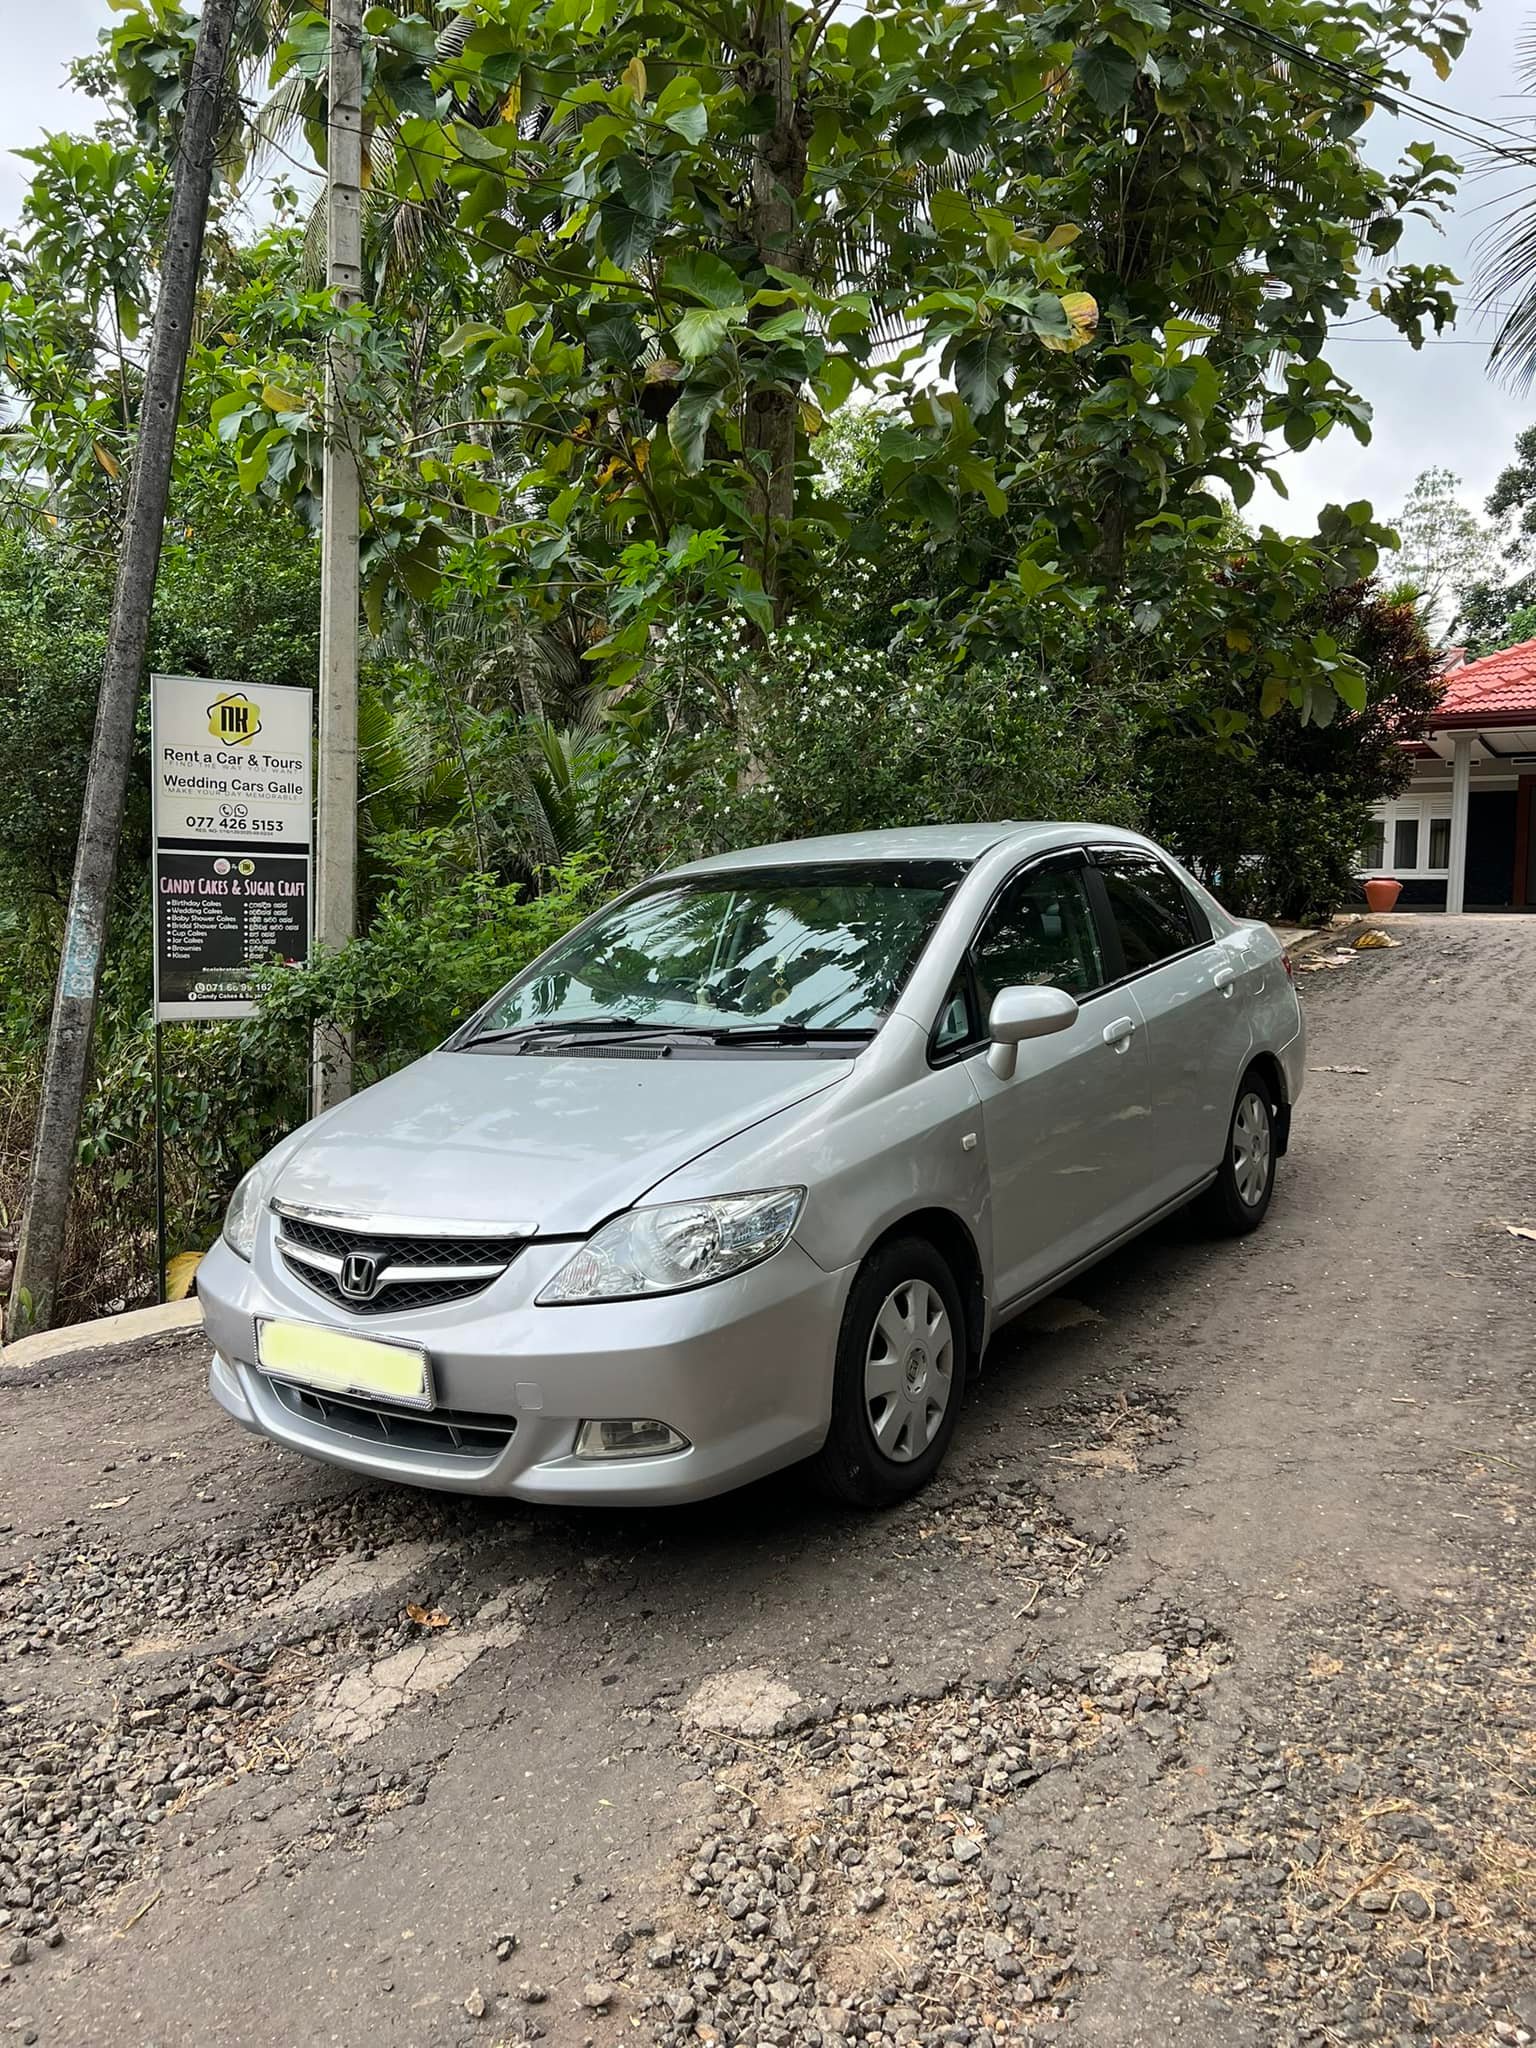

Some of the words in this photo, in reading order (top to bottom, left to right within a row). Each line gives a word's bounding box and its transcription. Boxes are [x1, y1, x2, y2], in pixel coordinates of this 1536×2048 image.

[164, 748, 200, 762] Rent
[203, 753, 212, 763] a
[216, 752, 244, 765] Car
[247, 754, 259, 766] &
[262, 755, 303, 770] Tours
[164, 774, 227, 792] Wedding
[231, 779, 264, 792] Cars
[267, 781, 303, 795] Galle
[197, 788, 220, 796] YOUR
[186, 816, 214, 828] 077
[219, 818, 247, 830] 426
[251, 819, 284, 832] 5153
[159, 876, 195, 894] CANDY
[198, 877, 229, 896] CAKES
[231, 879, 241, 896] &
[244, 879, 276, 896] SUGAR
[277, 880, 305, 897] CRAFT
[171, 899, 200, 908] Birthday
[201, 899, 222, 907] Cakes
[171, 907, 202, 915] Wedding
[202, 907, 223, 915] Cakes
[171, 914, 190, 922] Baby
[191, 914, 216, 922] Shower
[193, 922, 218, 930] Shower
[218, 922, 239, 930] Cakes
[171, 929, 186, 937] Cup
[187, 929, 208, 937] Cakes
[183, 936, 204, 944] Cakes
[171, 944, 202, 952] Brownies
